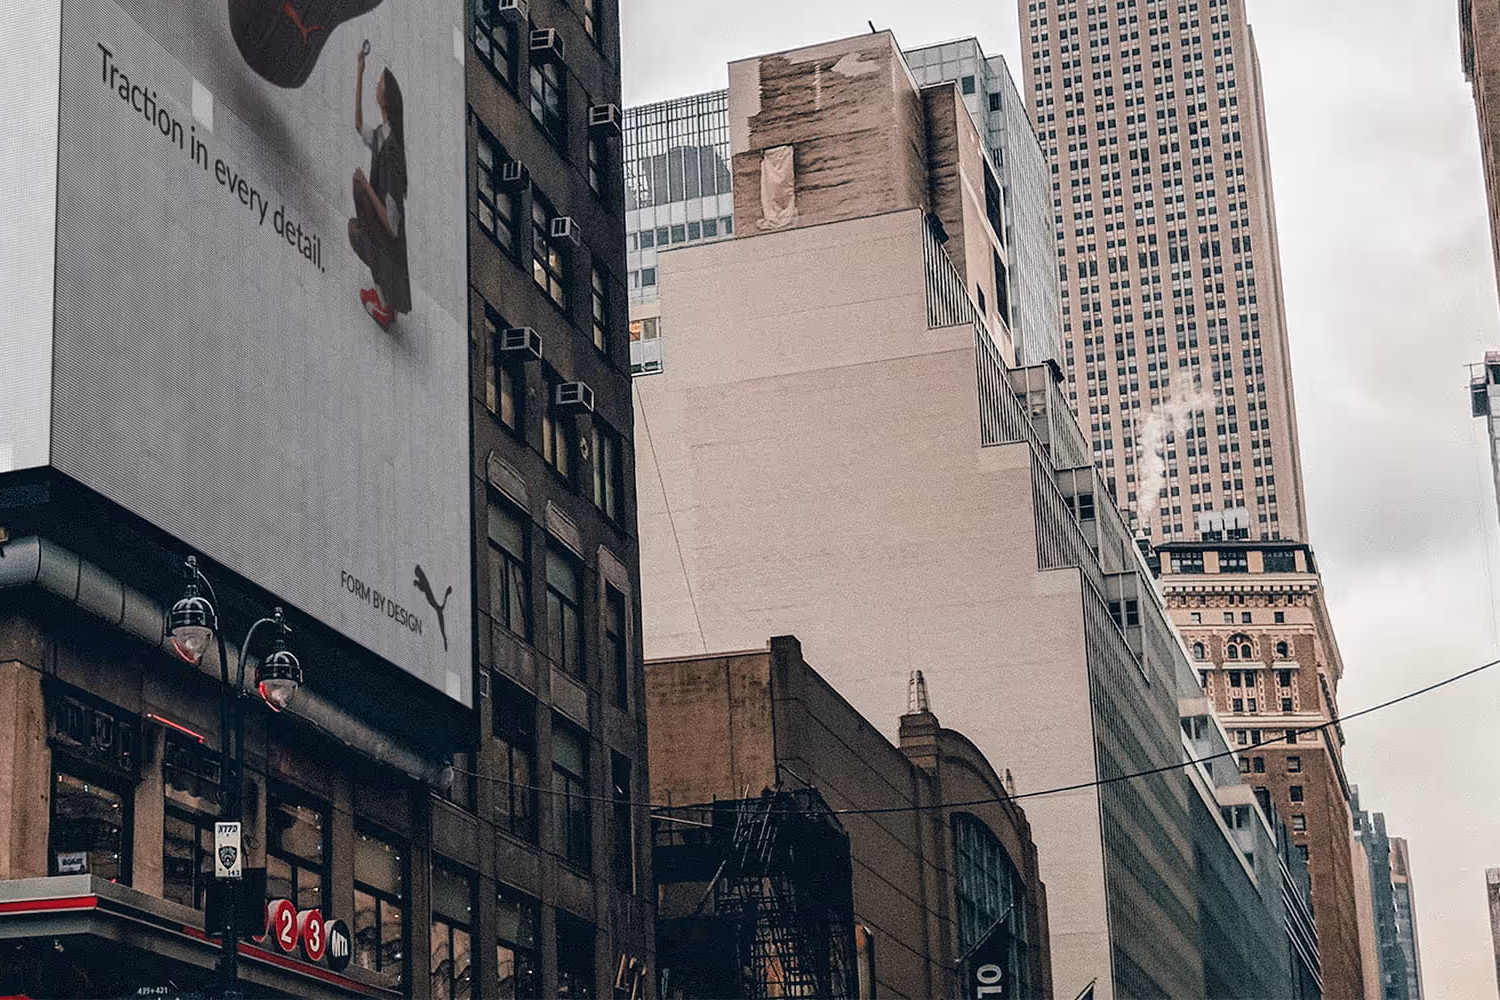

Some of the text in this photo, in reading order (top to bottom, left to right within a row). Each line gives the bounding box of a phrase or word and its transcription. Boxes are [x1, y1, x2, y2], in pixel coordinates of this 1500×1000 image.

[97, 42, 326, 273] Traction in every detail.
[340, 569, 422, 636] FORM BY DESIGN
[218, 824, 238, 833] NYPD
[281, 909, 349, 958] 2 3 MTA
